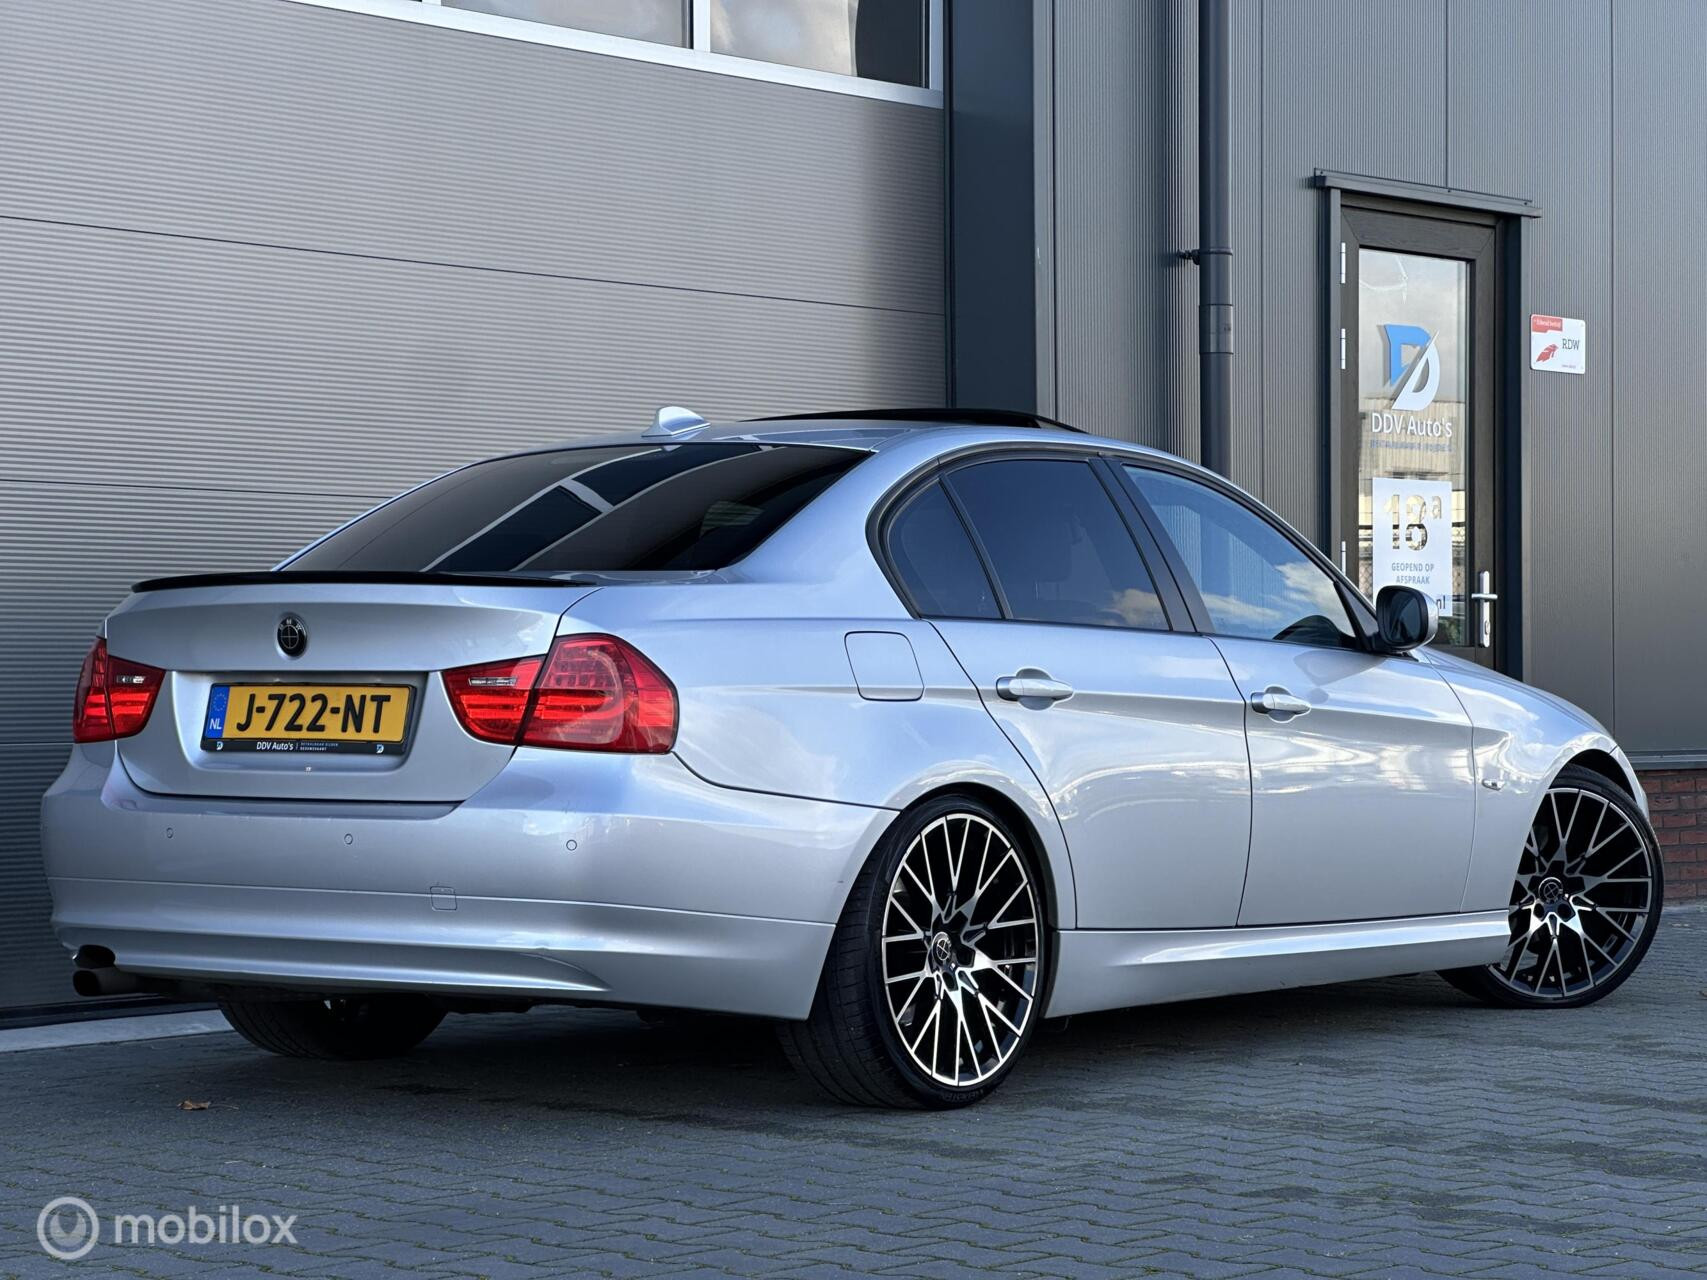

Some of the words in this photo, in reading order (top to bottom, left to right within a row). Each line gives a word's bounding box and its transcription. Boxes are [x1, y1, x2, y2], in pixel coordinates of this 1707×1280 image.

[1562, 338, 1580, 350] RDW
[1372, 412, 1403, 434] DDV
[1407, 415, 1453, 438] Auto's
[1391, 562, 1423, 572] GEOPEND
[1425, 563, 1435, 572] OP
[1396, 575, 1430, 584] AFSPRAAK
[236, 693, 391, 734] J-722-NT
[209, 718, 222, 730] NL
[256, 741, 272, 750] DDV
[272, 742, 294, 751] Auto's
